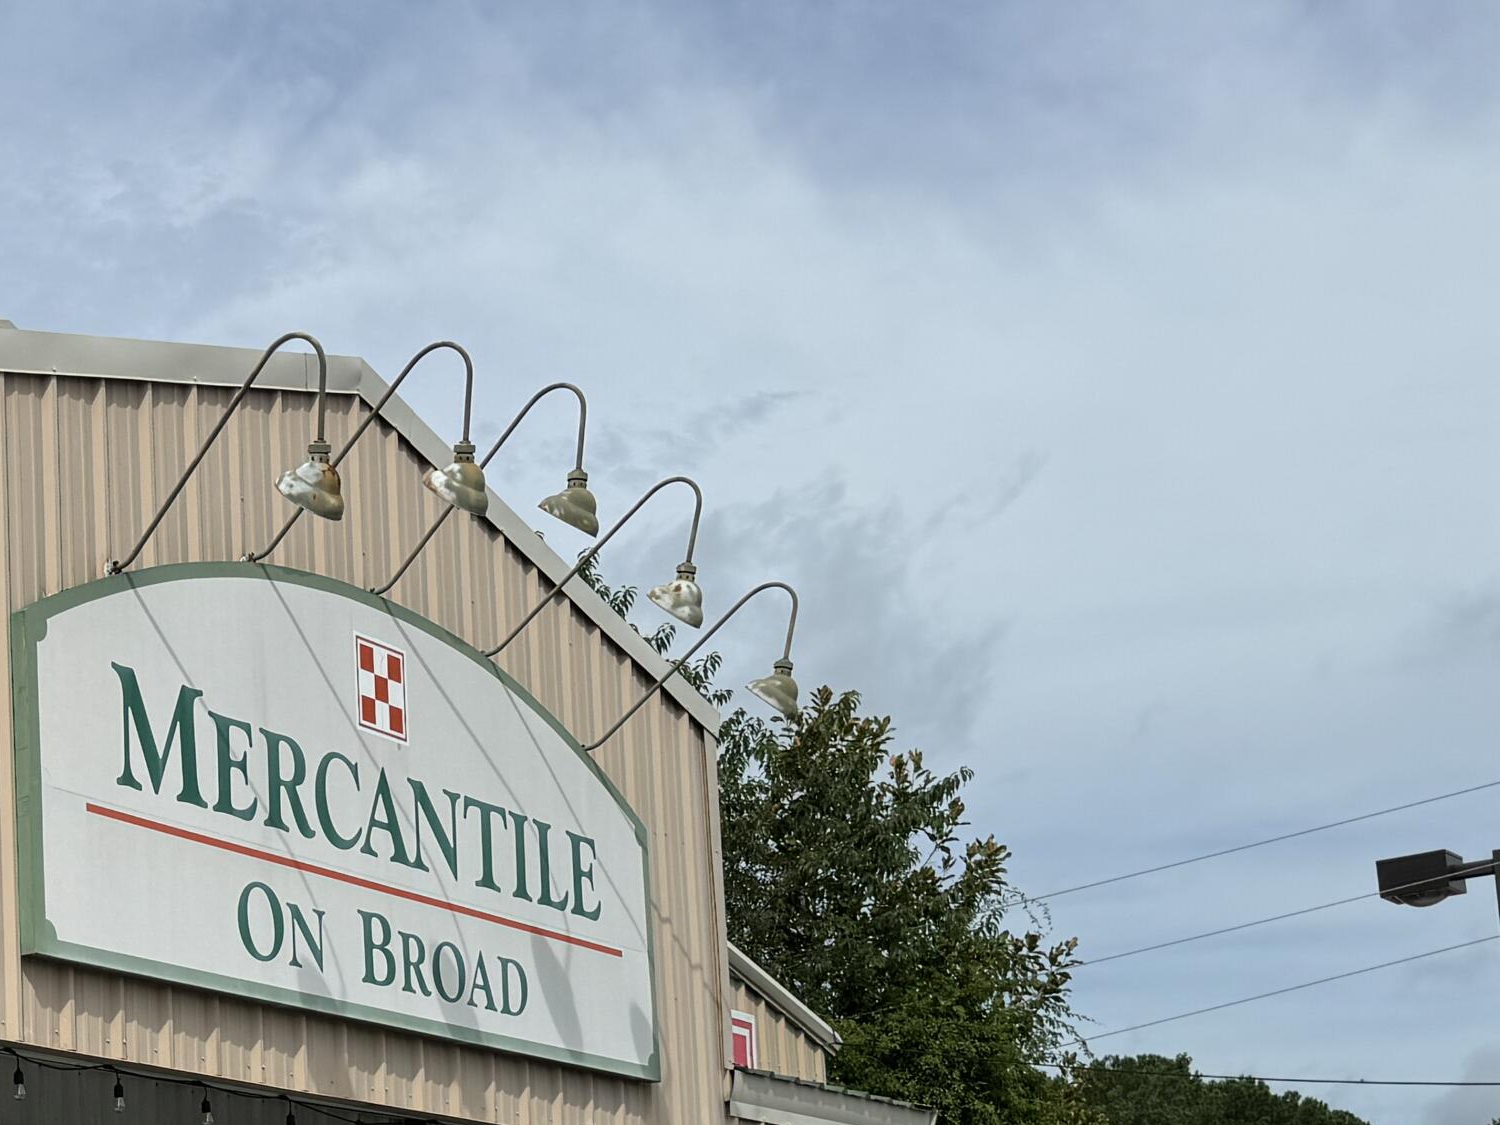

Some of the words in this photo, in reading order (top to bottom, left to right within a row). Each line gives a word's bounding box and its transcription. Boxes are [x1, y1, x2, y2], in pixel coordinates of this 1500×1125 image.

[111, 661, 602, 921] MERCANTILE
[237, 880, 326, 974] ON
[357, 909, 528, 1017] BROAD
